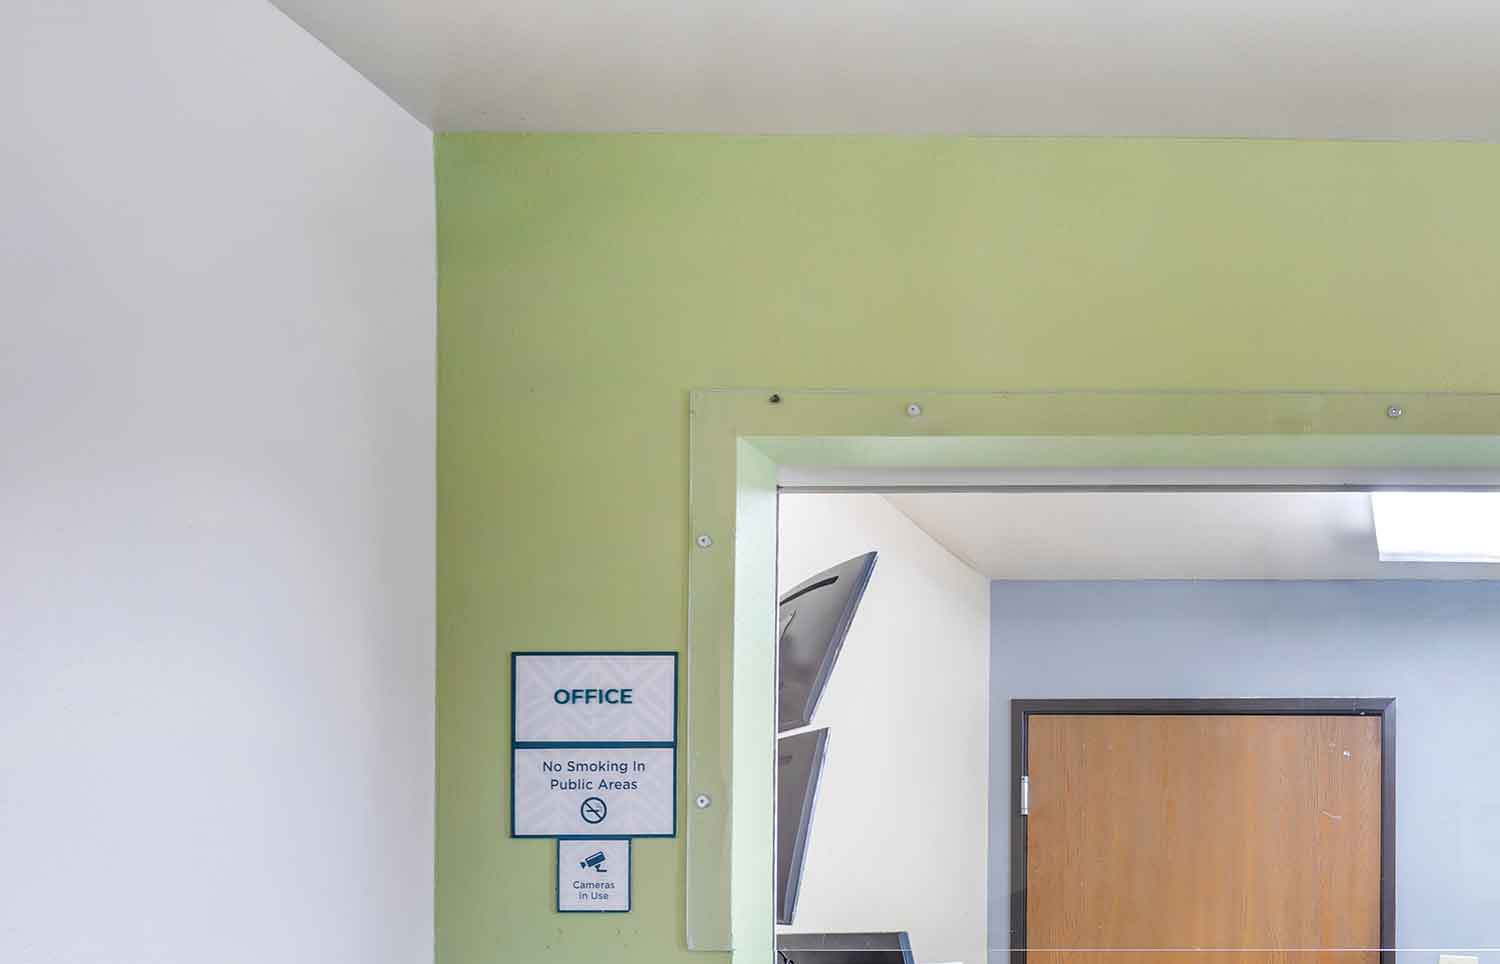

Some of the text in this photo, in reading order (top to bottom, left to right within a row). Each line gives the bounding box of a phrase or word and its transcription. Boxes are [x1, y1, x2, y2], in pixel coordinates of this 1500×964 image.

[554, 689, 632, 704] OFFICE
[543, 761, 645, 774] No Smoking In
[551, 779, 637, 790] Public Areas
[573, 881, 615, 889] Cameras
